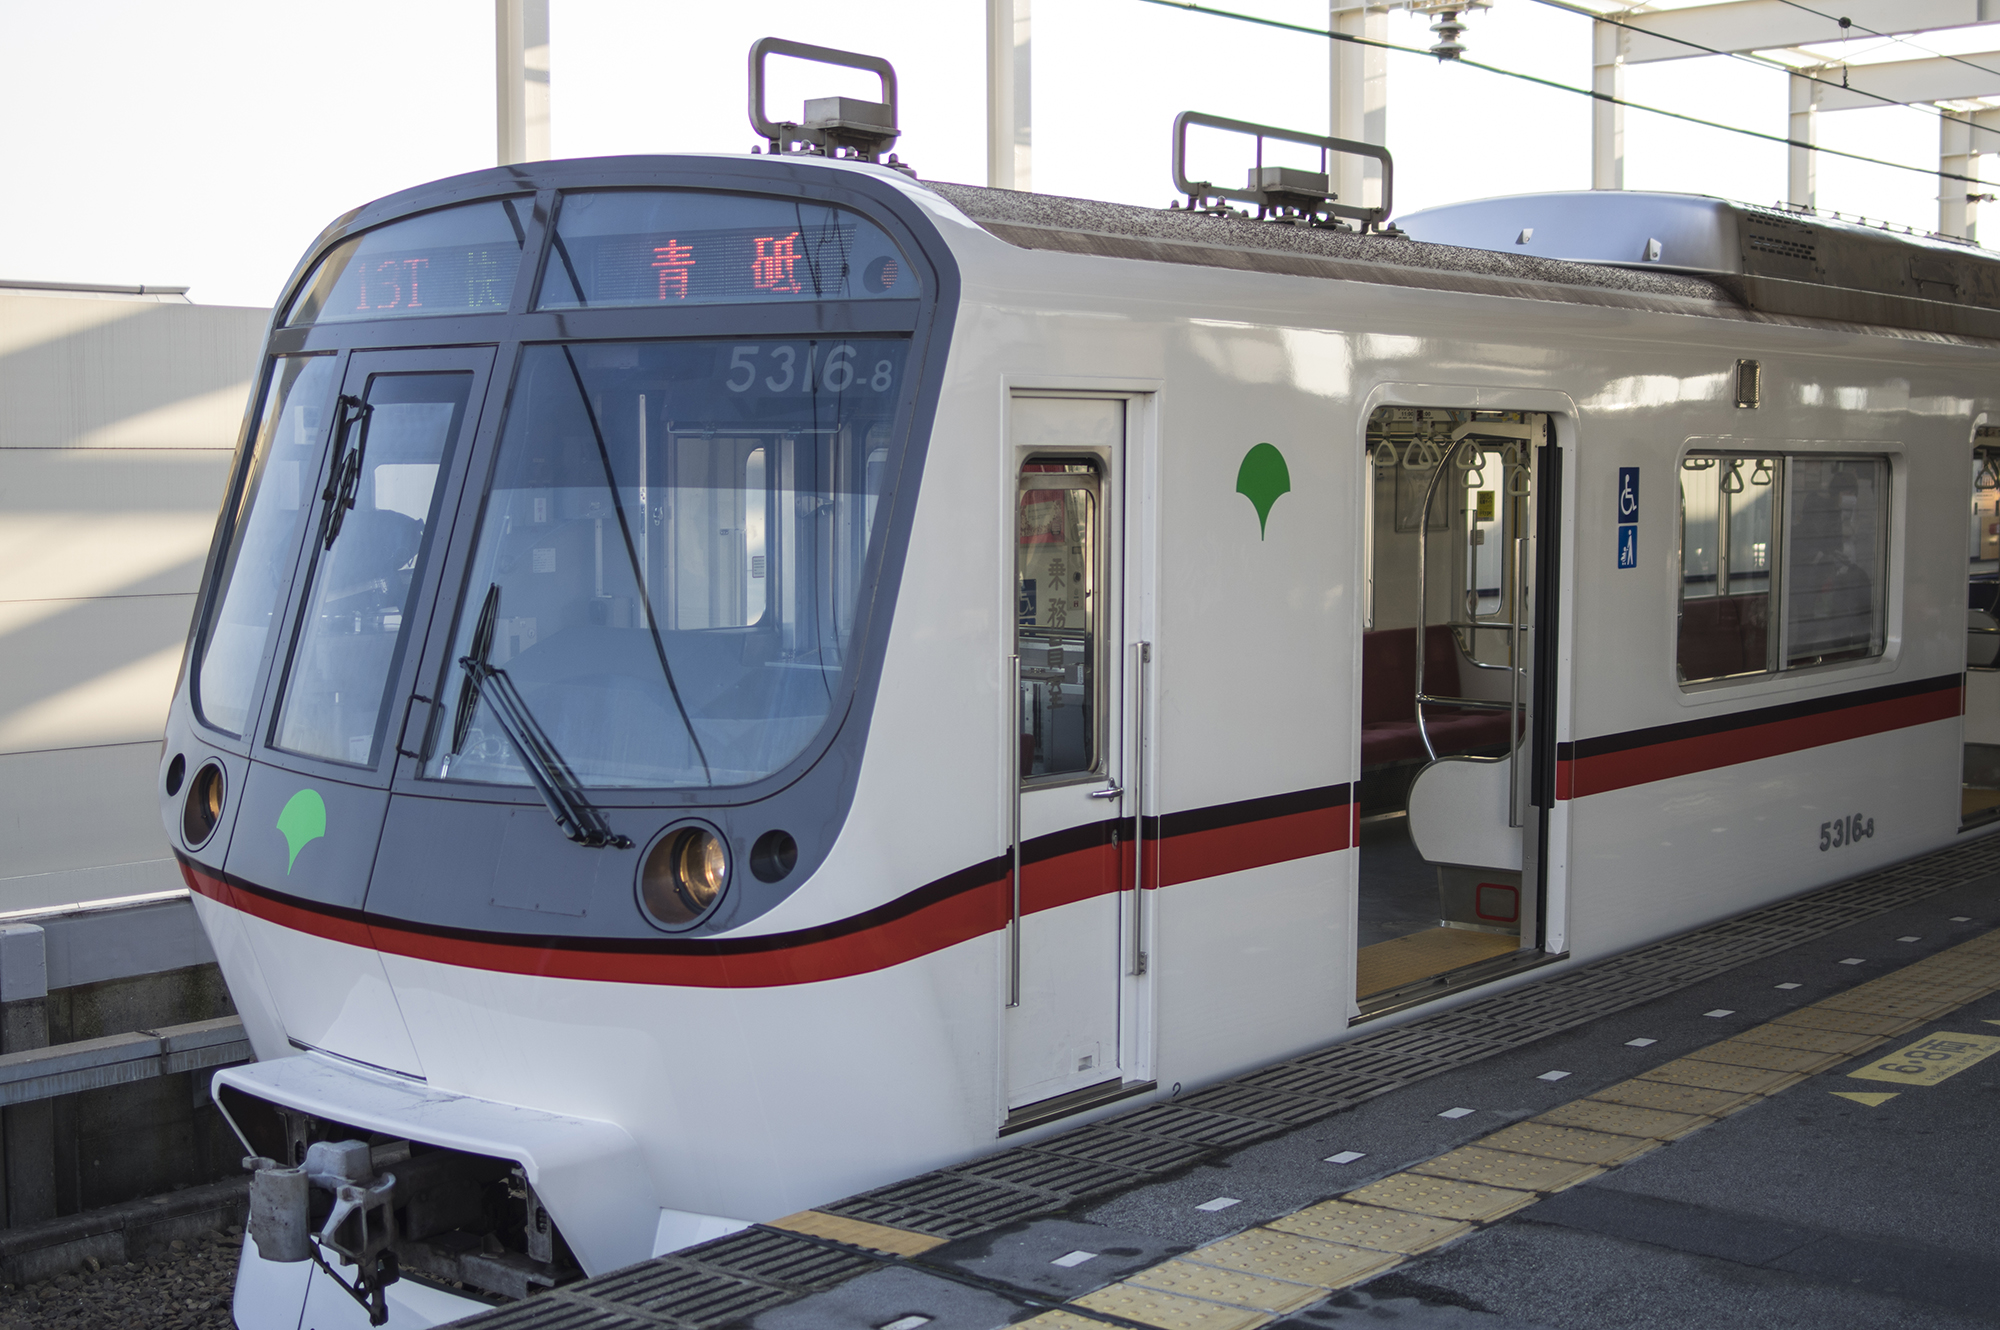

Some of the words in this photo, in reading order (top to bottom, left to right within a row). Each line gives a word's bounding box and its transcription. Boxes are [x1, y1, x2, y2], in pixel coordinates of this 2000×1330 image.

[651, 231, 802, 300] 青砥
[725, 345, 893, 393] 5316-8
[1819, 812, 1875, 852] 5316-8
